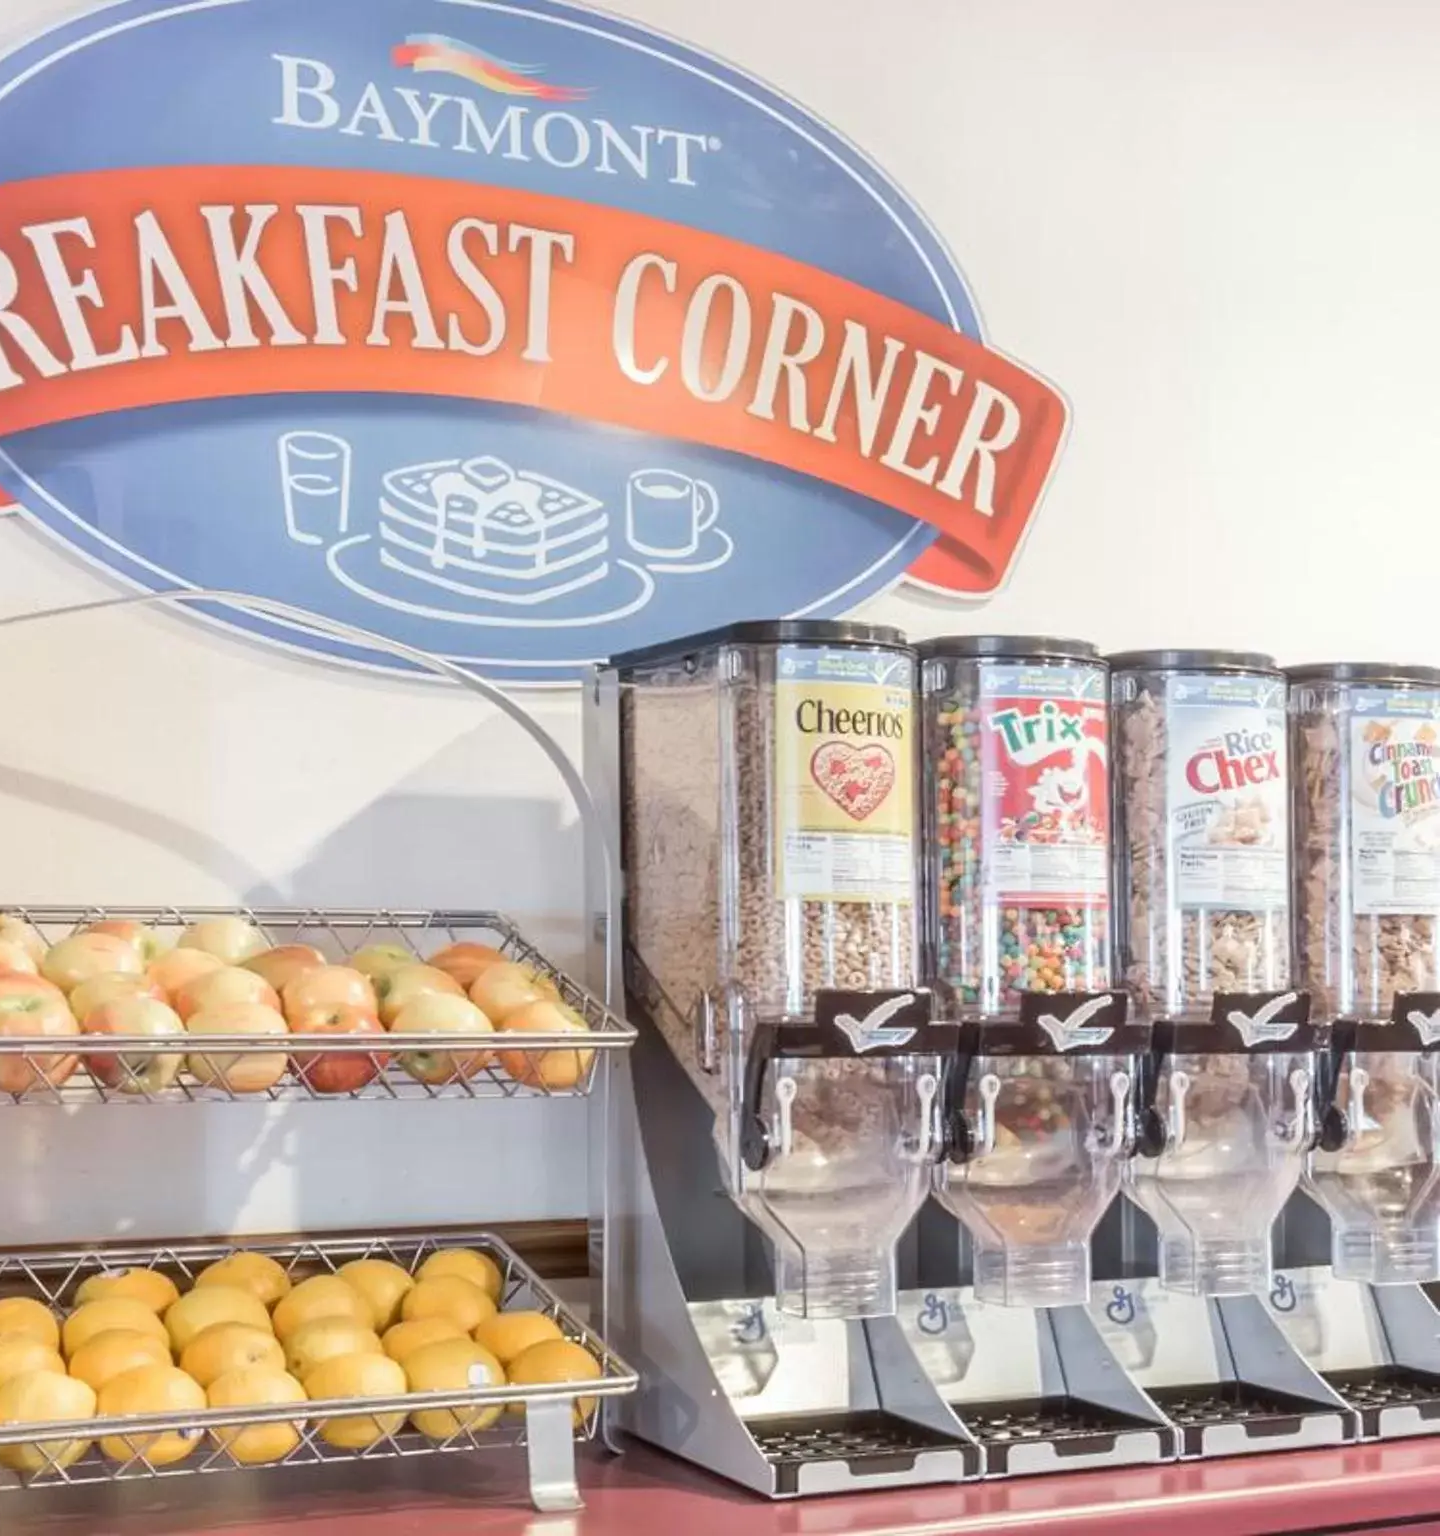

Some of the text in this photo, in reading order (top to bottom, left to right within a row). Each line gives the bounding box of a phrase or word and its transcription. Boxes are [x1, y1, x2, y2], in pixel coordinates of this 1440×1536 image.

[613, 253, 1021, 517] CORNER
[796, 698, 904, 740] Cheerios
[991, 704, 1082, 753] Trix
[1224, 728, 1272, 756] Rice
[1186, 750, 1280, 793] Chex
